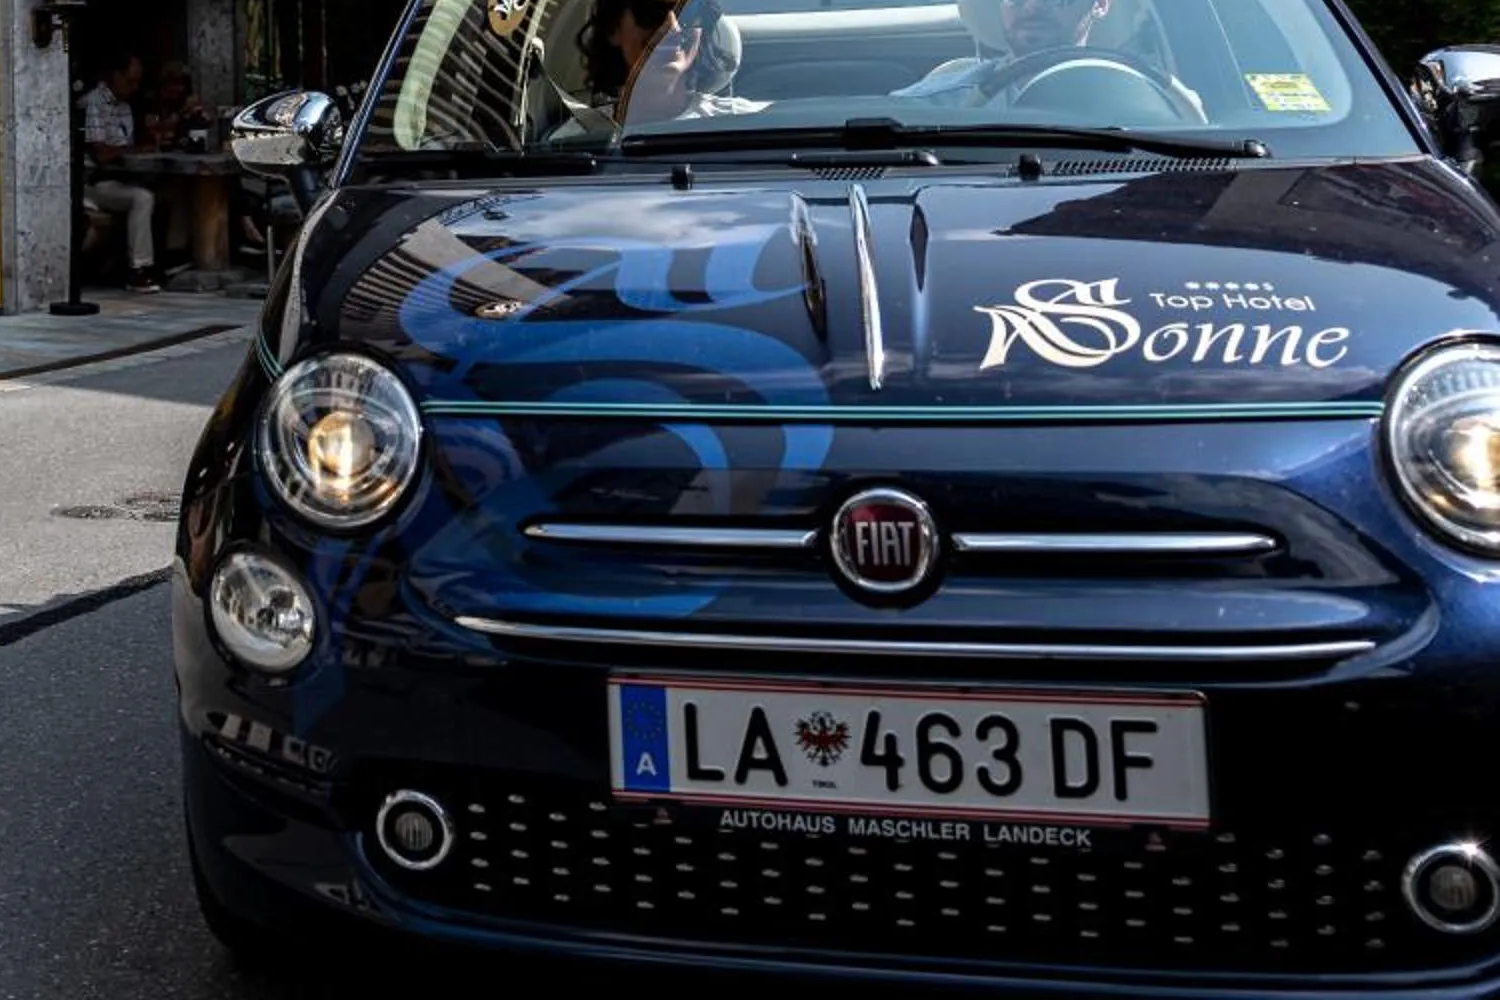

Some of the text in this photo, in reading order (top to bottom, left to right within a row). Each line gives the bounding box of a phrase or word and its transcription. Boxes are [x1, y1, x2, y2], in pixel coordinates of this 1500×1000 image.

[1148, 292, 1316, 312] Top Hotel
[855, 520, 915, 566] FIAT
[636, 702, 1159, 802] A LA 463 DF
[720, 809, 1092, 846] AUTOHAUS MASCHLER LANDECK
